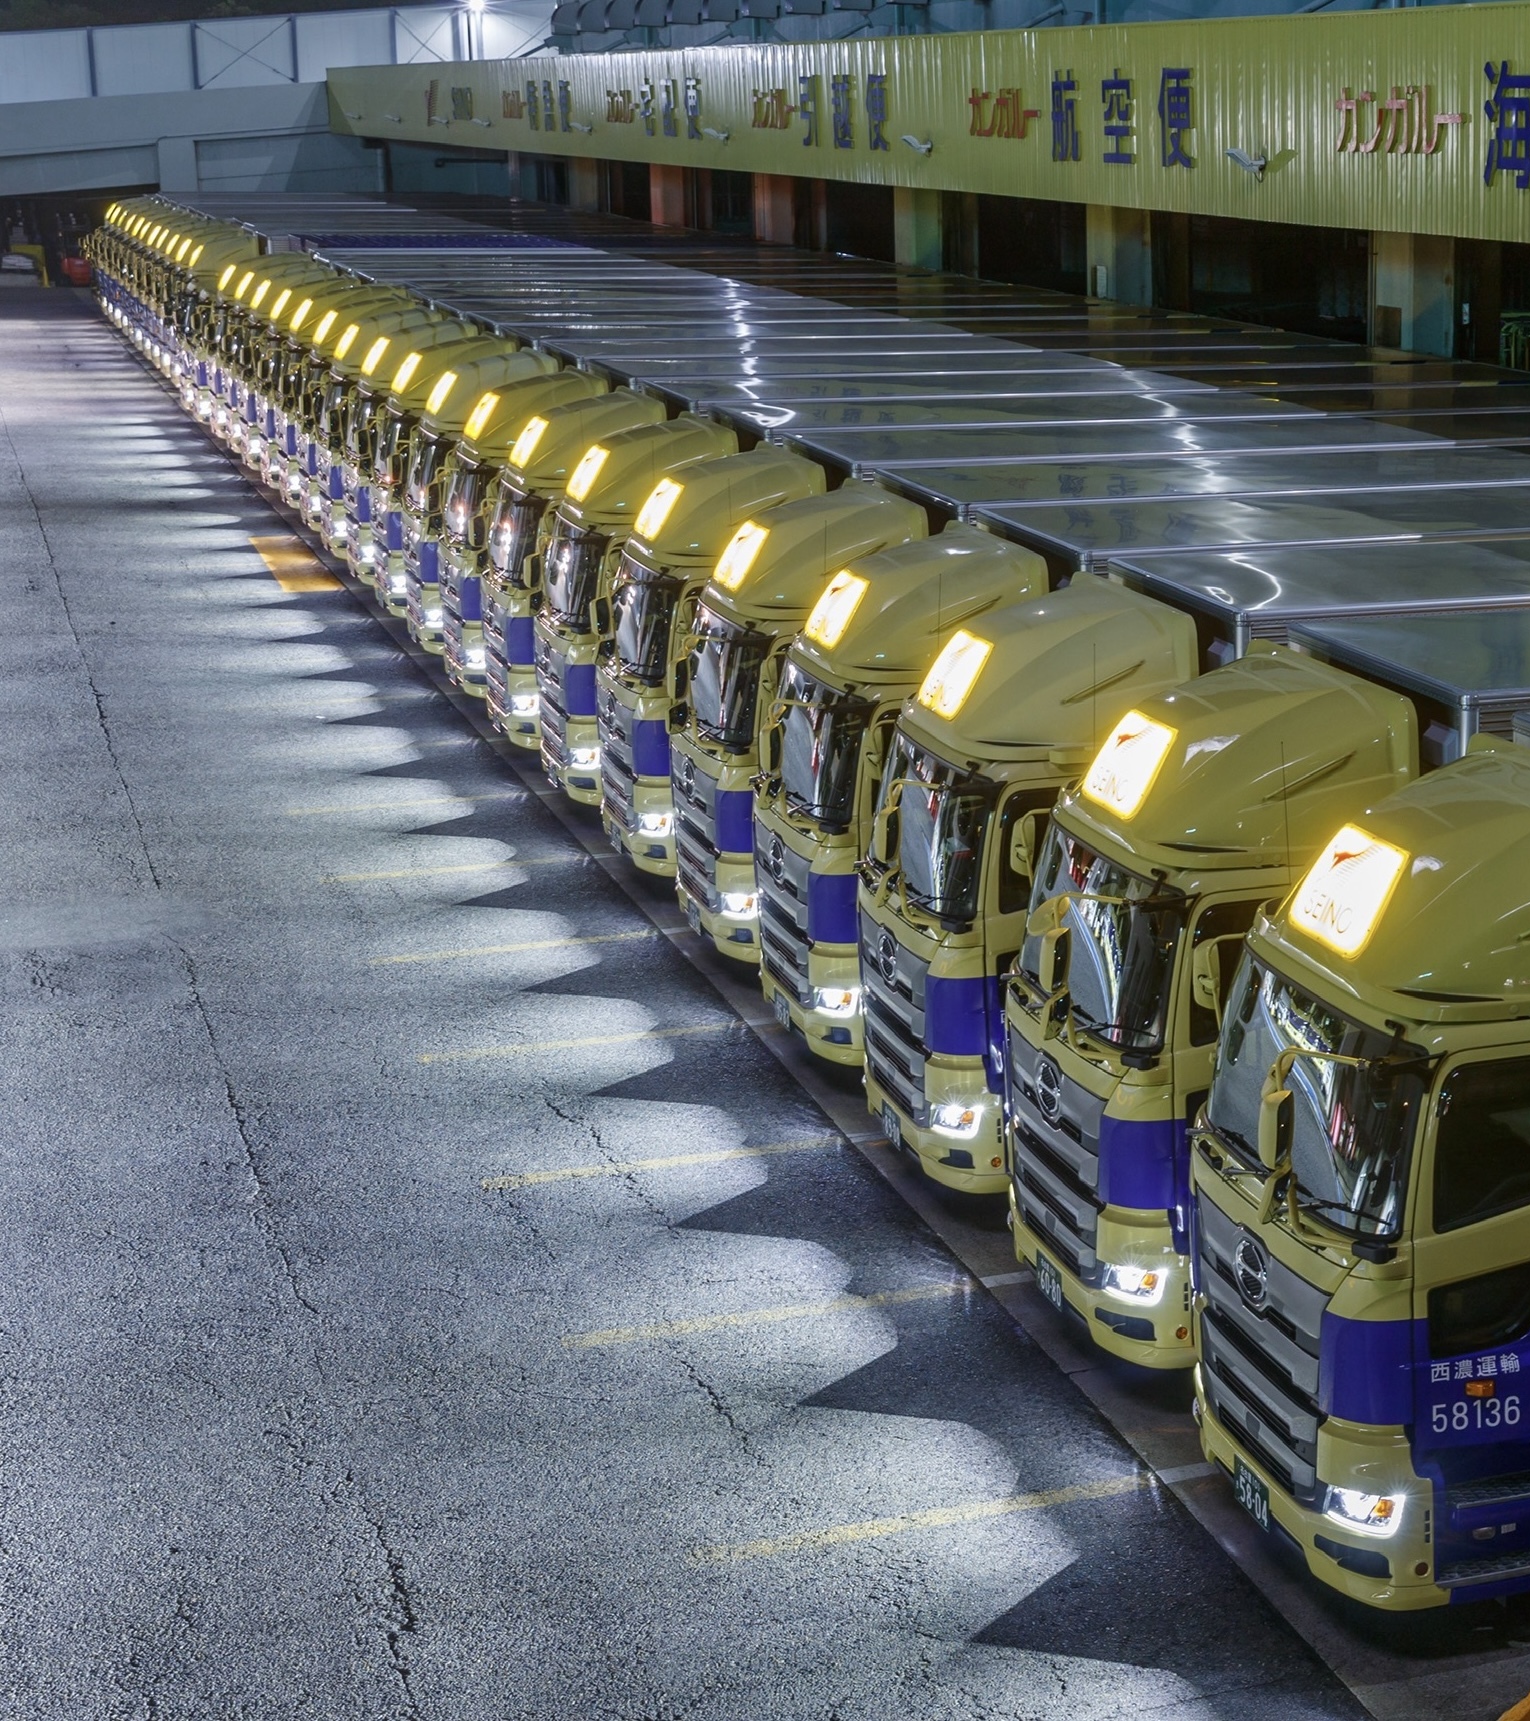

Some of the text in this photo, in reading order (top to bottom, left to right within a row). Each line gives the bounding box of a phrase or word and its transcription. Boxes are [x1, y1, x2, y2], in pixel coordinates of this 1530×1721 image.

[1052, 68, 1194, 168] 航空便
[1430, 1353, 1520, 1383] 西濃運輸
[1432, 1396, 1520, 1433] 58136
